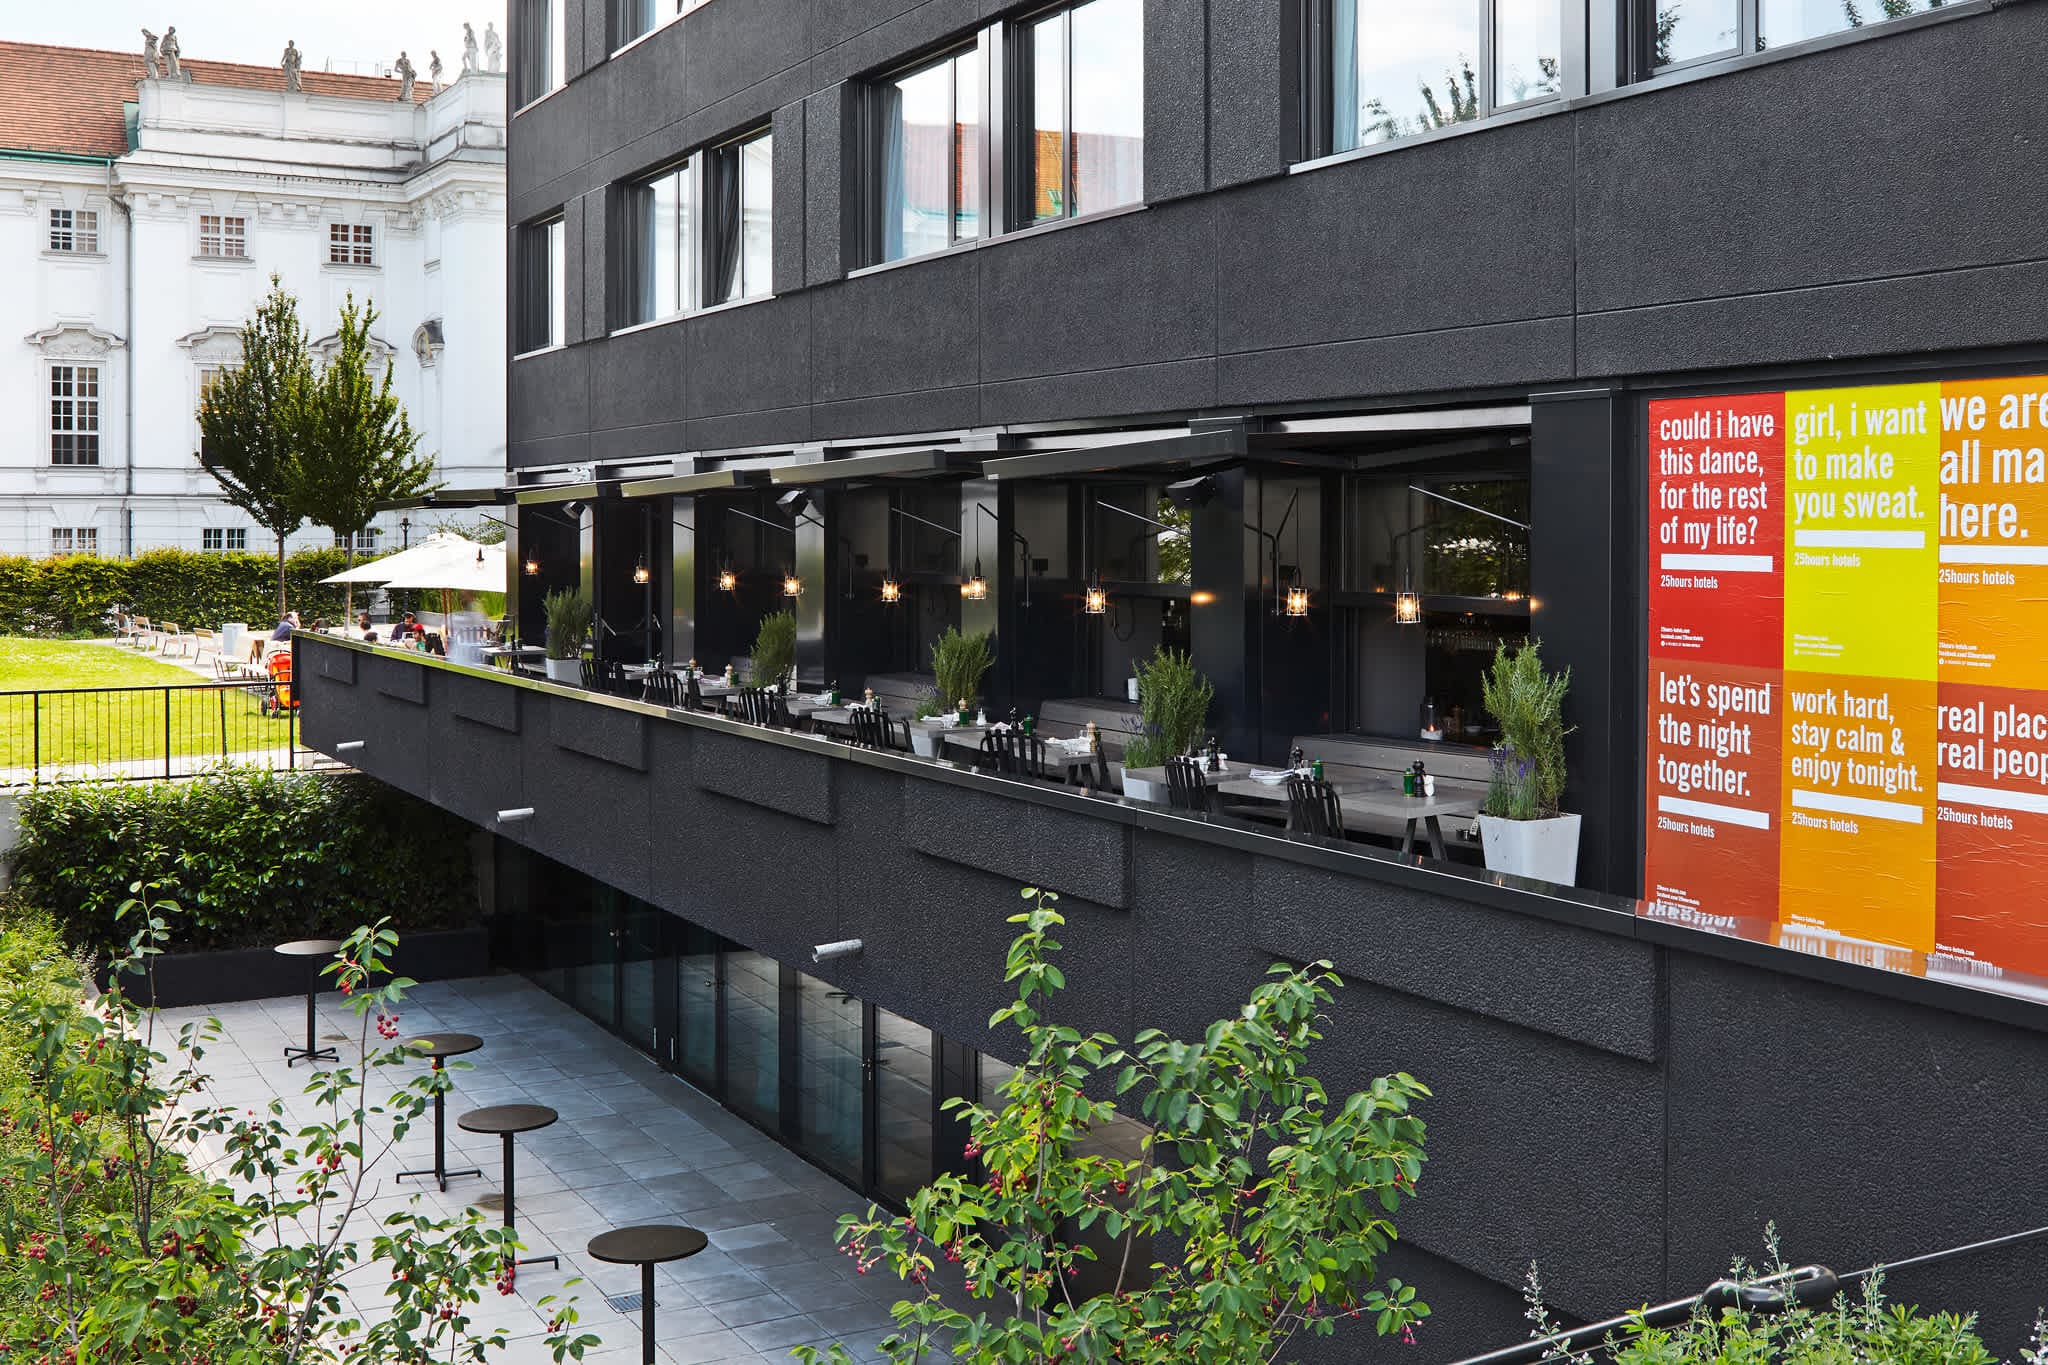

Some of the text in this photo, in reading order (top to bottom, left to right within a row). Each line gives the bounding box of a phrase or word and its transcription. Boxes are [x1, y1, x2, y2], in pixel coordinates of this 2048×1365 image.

[1660, 409, 1774, 440] could i have
[1794, 400, 1927, 445] girl, i want
[1939, 395, 1986, 431] we
[1660, 446, 1764, 477] this dance,
[1794, 445, 1894, 480] to make
[1939, 439, 1980, 485] all
[1660, 481, 1768, 509] for the rest
[1794, 485, 1925, 525] you sweat.
[1660, 515, 1758, 550] of my life?
[1939, 493, 2029, 538] here.
[1794, 552, 1861, 568] 25hours hotels
[1938, 568, 2015, 585] 25hours hotels
[1660, 574, 1719, 589] 25hours hotels
[1706, 682, 1771, 716] spend
[1791, 688, 1895, 725] work hard,
[1937, 701, 1985, 734] real
[1658, 712, 1751, 758] the night
[1791, 720, 1905, 757] stay calm &
[1937, 738, 1984, 771] real
[1657, 753, 1751, 797] together.
[1791, 753, 1924, 794] enjoy tonight.
[1657, 816, 1716, 839] 25hours hotels
[1791, 811, 1859, 834] 25hours hotels
[1937, 806, 2014, 831] 25hours hotels
